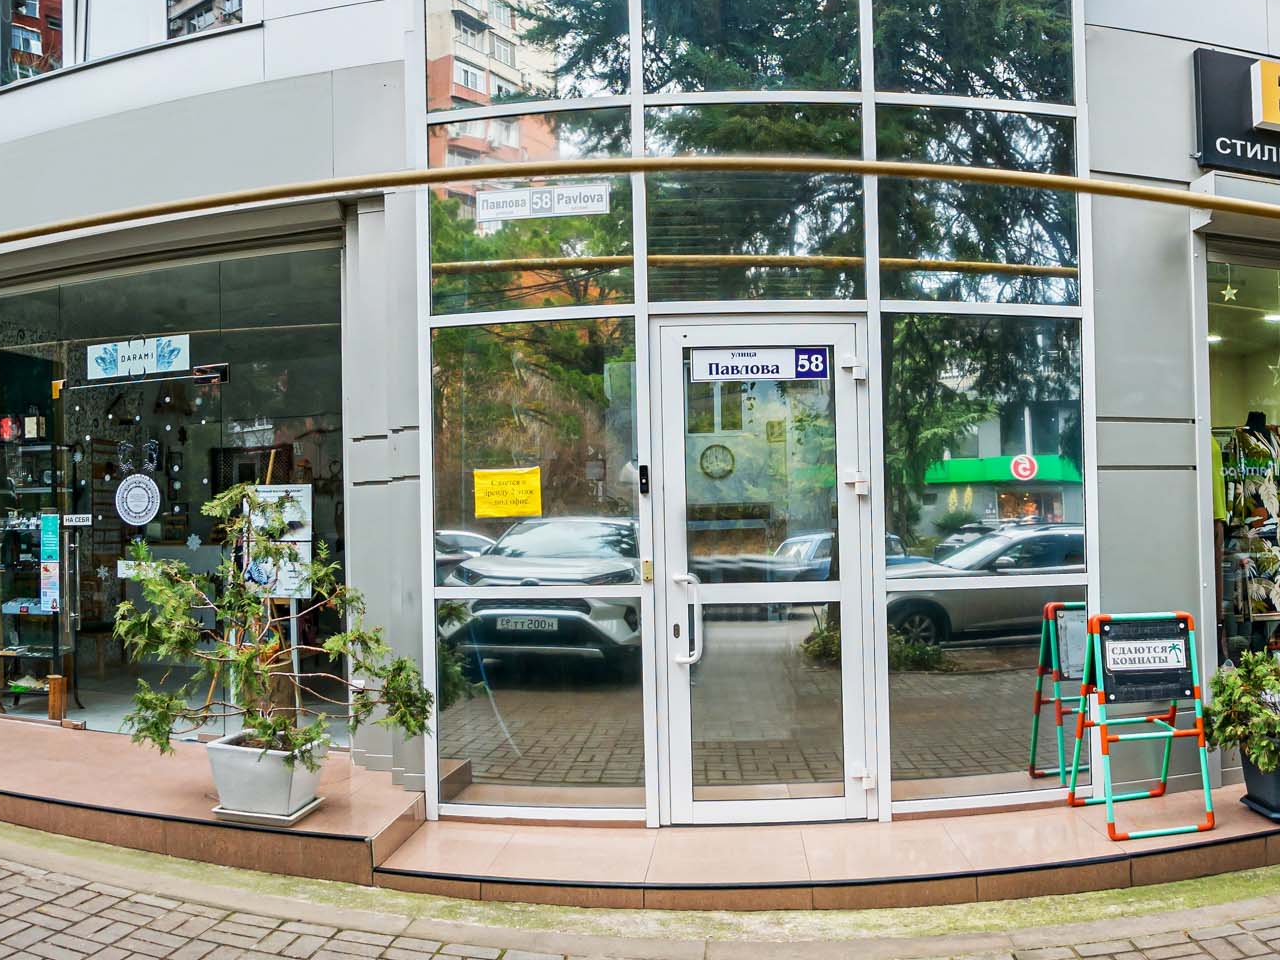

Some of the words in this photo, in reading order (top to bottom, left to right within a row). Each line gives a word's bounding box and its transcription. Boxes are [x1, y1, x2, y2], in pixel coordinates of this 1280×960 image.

[481, 199, 527, 211] Павлова
[532, 191, 552, 210] 58
[557, 191, 604, 205] Pavlova
[121, 352, 154, 362] DARAMI
[731, 350, 757, 359] улица
[708, 363, 780, 376] Павлова
[797, 354, 824, 372] 58
[1111, 645, 1168, 656] СДАЮТСЯ
[1112, 656, 1169, 666] КОМНАТЫ
